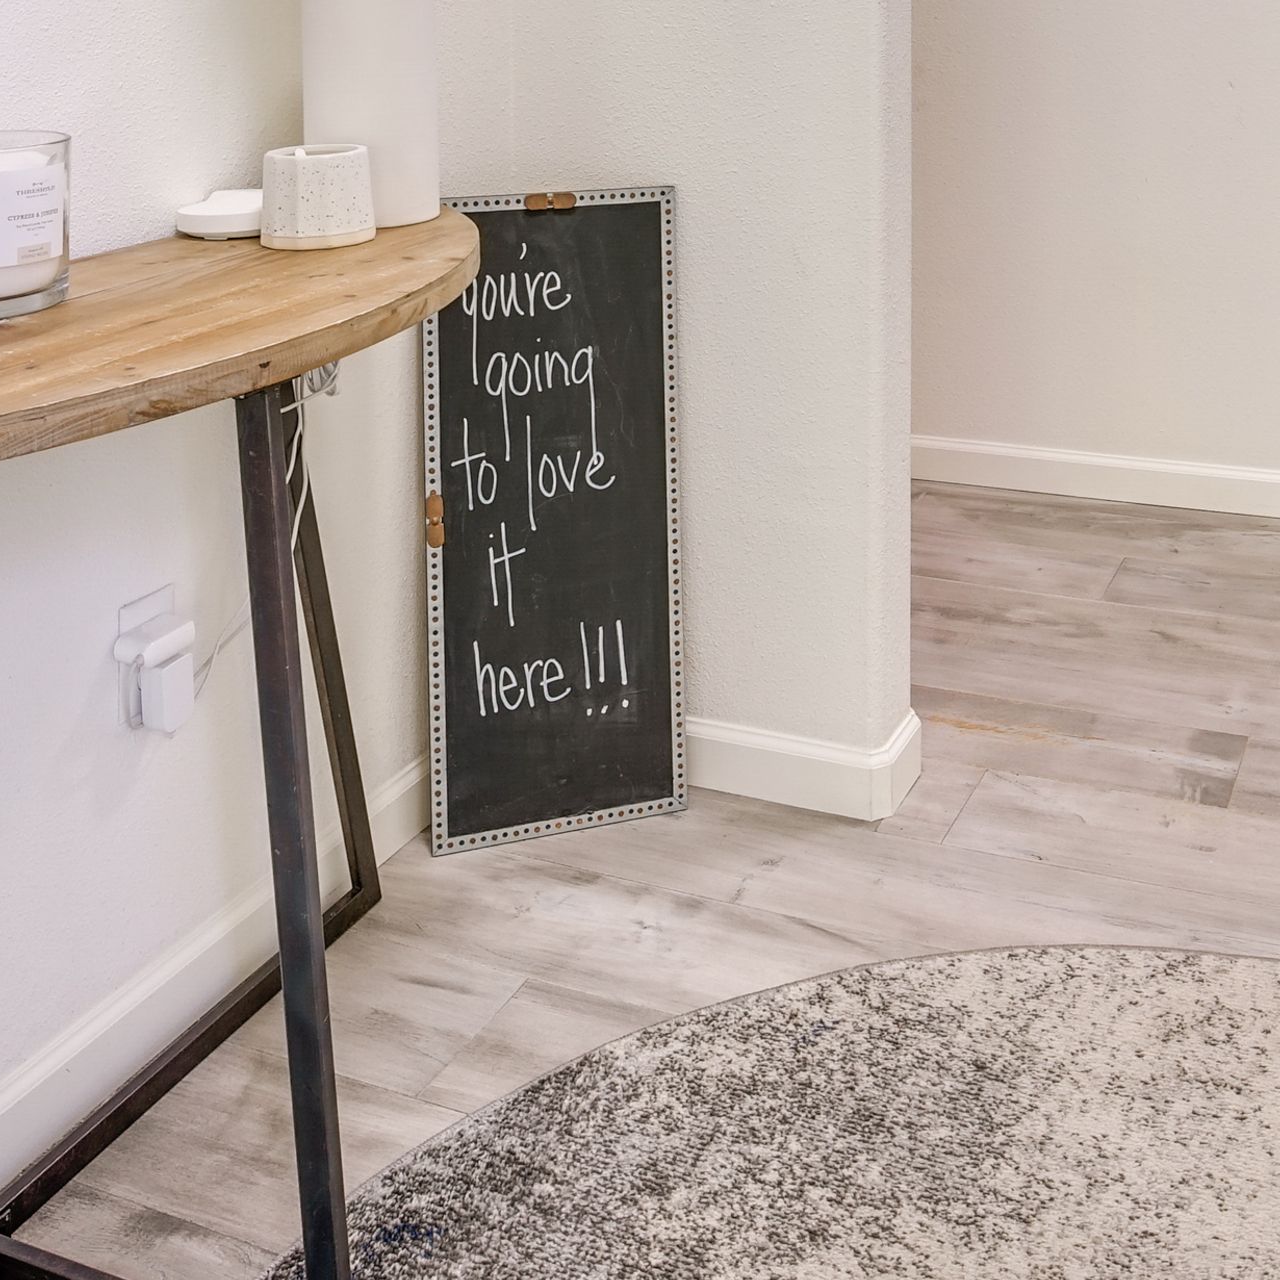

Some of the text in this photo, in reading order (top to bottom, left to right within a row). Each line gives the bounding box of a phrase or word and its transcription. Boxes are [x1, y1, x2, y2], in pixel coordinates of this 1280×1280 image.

[462, 242, 572, 386] you're
[485, 337, 600, 465] going
[450, 415, 617, 533] to love
[488, 521, 527, 628] it
